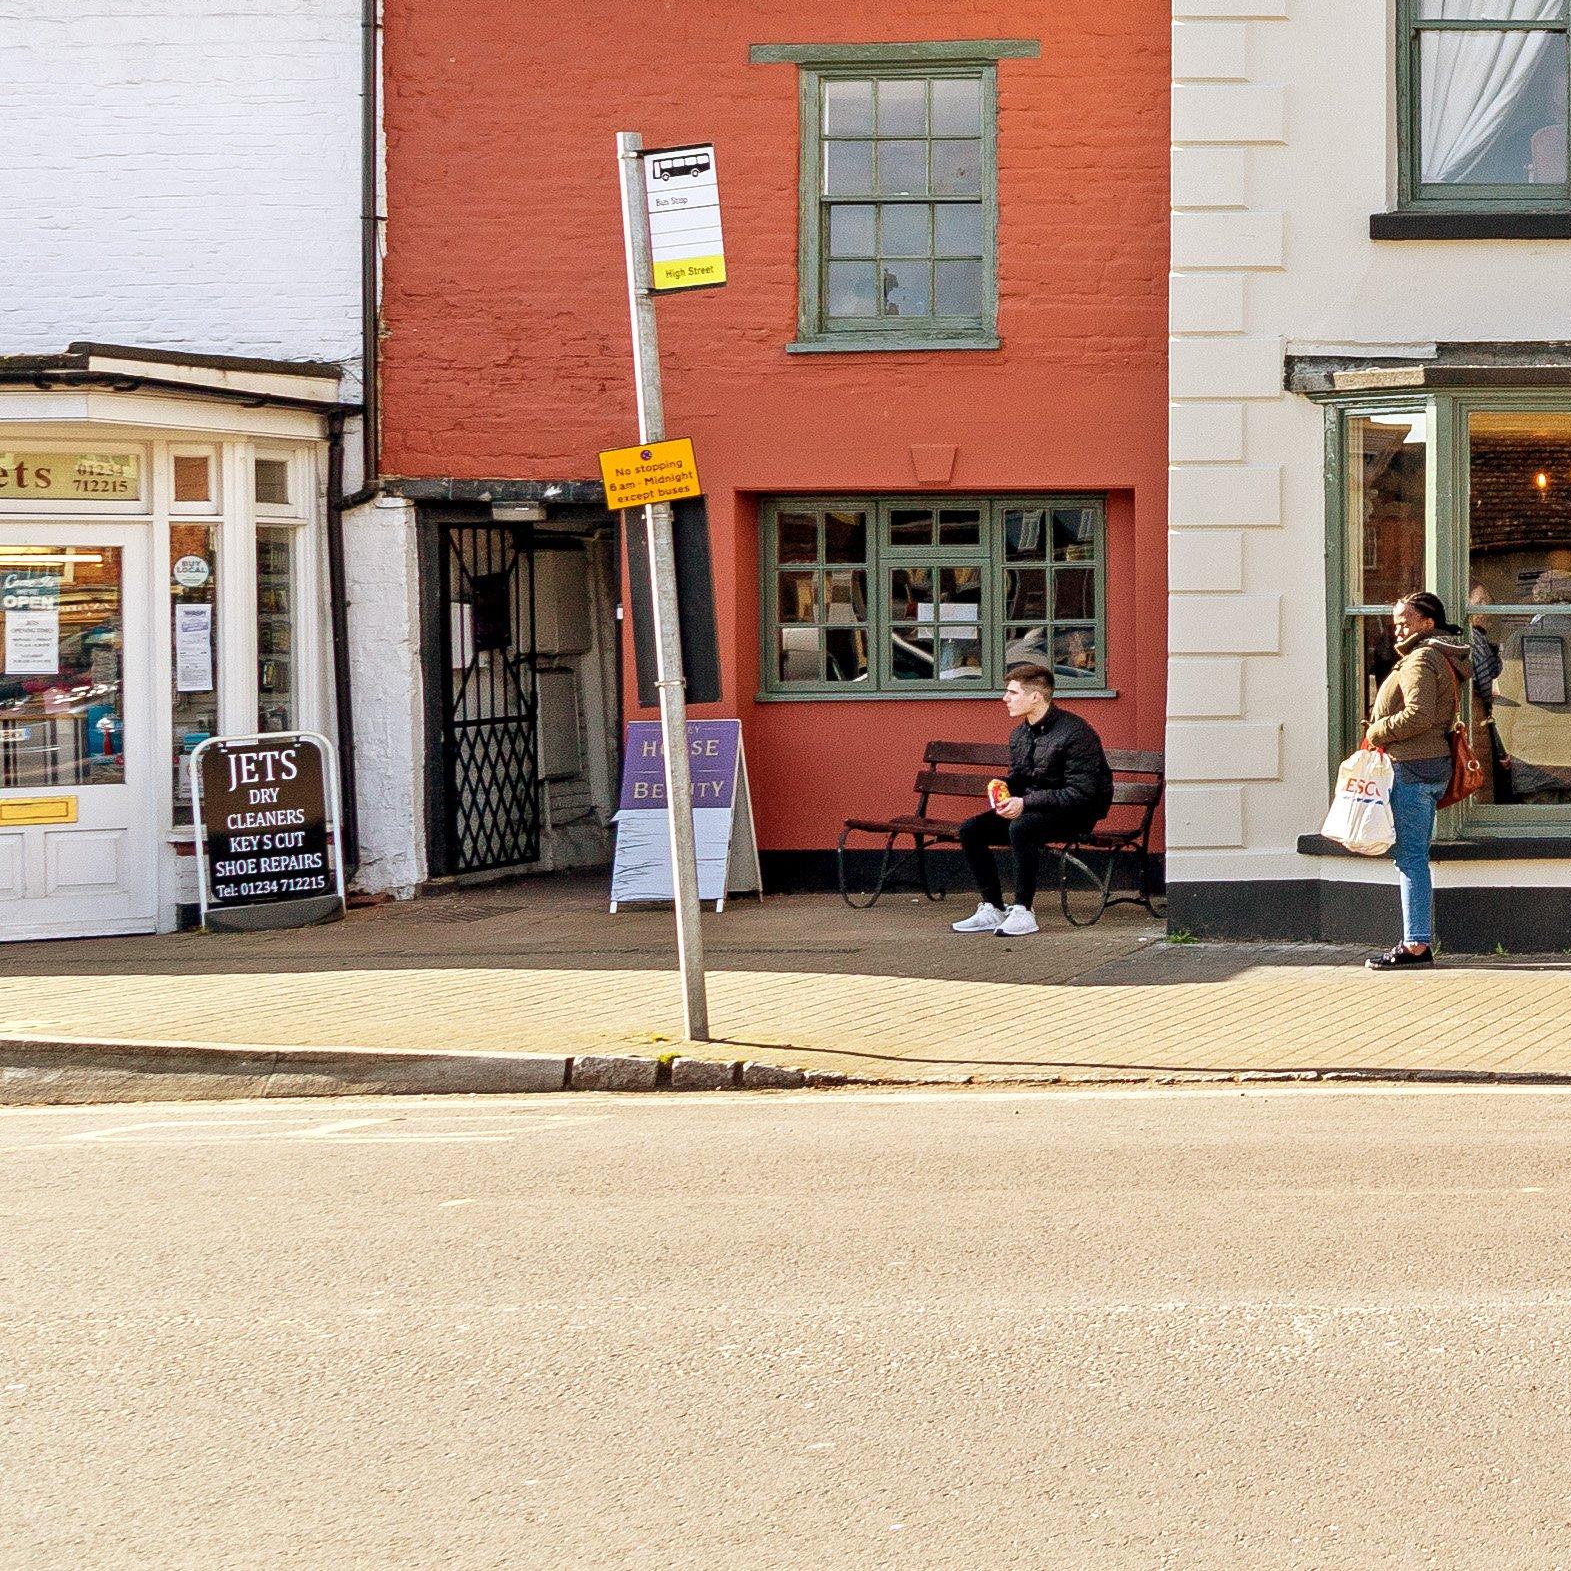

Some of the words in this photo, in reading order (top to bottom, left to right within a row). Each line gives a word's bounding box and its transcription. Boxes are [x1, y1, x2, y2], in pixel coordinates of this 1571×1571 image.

[655, 198, 669, 206] Bus
[671, 197, 688, 206] Stop
[665, 268, 686, 280] High
[688, 265, 714, 277] Street
[615, 467, 632, 477] No
[634, 460, 683, 474] stopping
[72, 479, 129, 493] 712215
[644, 471, 694, 486] Midnight
[617, 490, 655, 503] except
[658, 485, 691, 497] buses
[176, 566, 208, 574] LOCAL
[181, 560, 202, 569] BUY
[3, 595, 56, 610] OPEN
[641, 739, 720, 758] HSE
[227, 749, 298, 792] JETS
[249, 787, 280, 805] DRY
[633, 780, 725, 799] BETY
[1345, 777, 1382, 797] ESC
[227, 808, 306, 830] CLEANERS
[275, 831, 306, 849] CUT
[215, 858, 257, 877] SHOE
[260, 853, 323, 873] REPAIRS
[215, 883, 238, 898] Tel:
[240, 880, 278, 896] 01234
[281, 875, 326, 892] 712215
